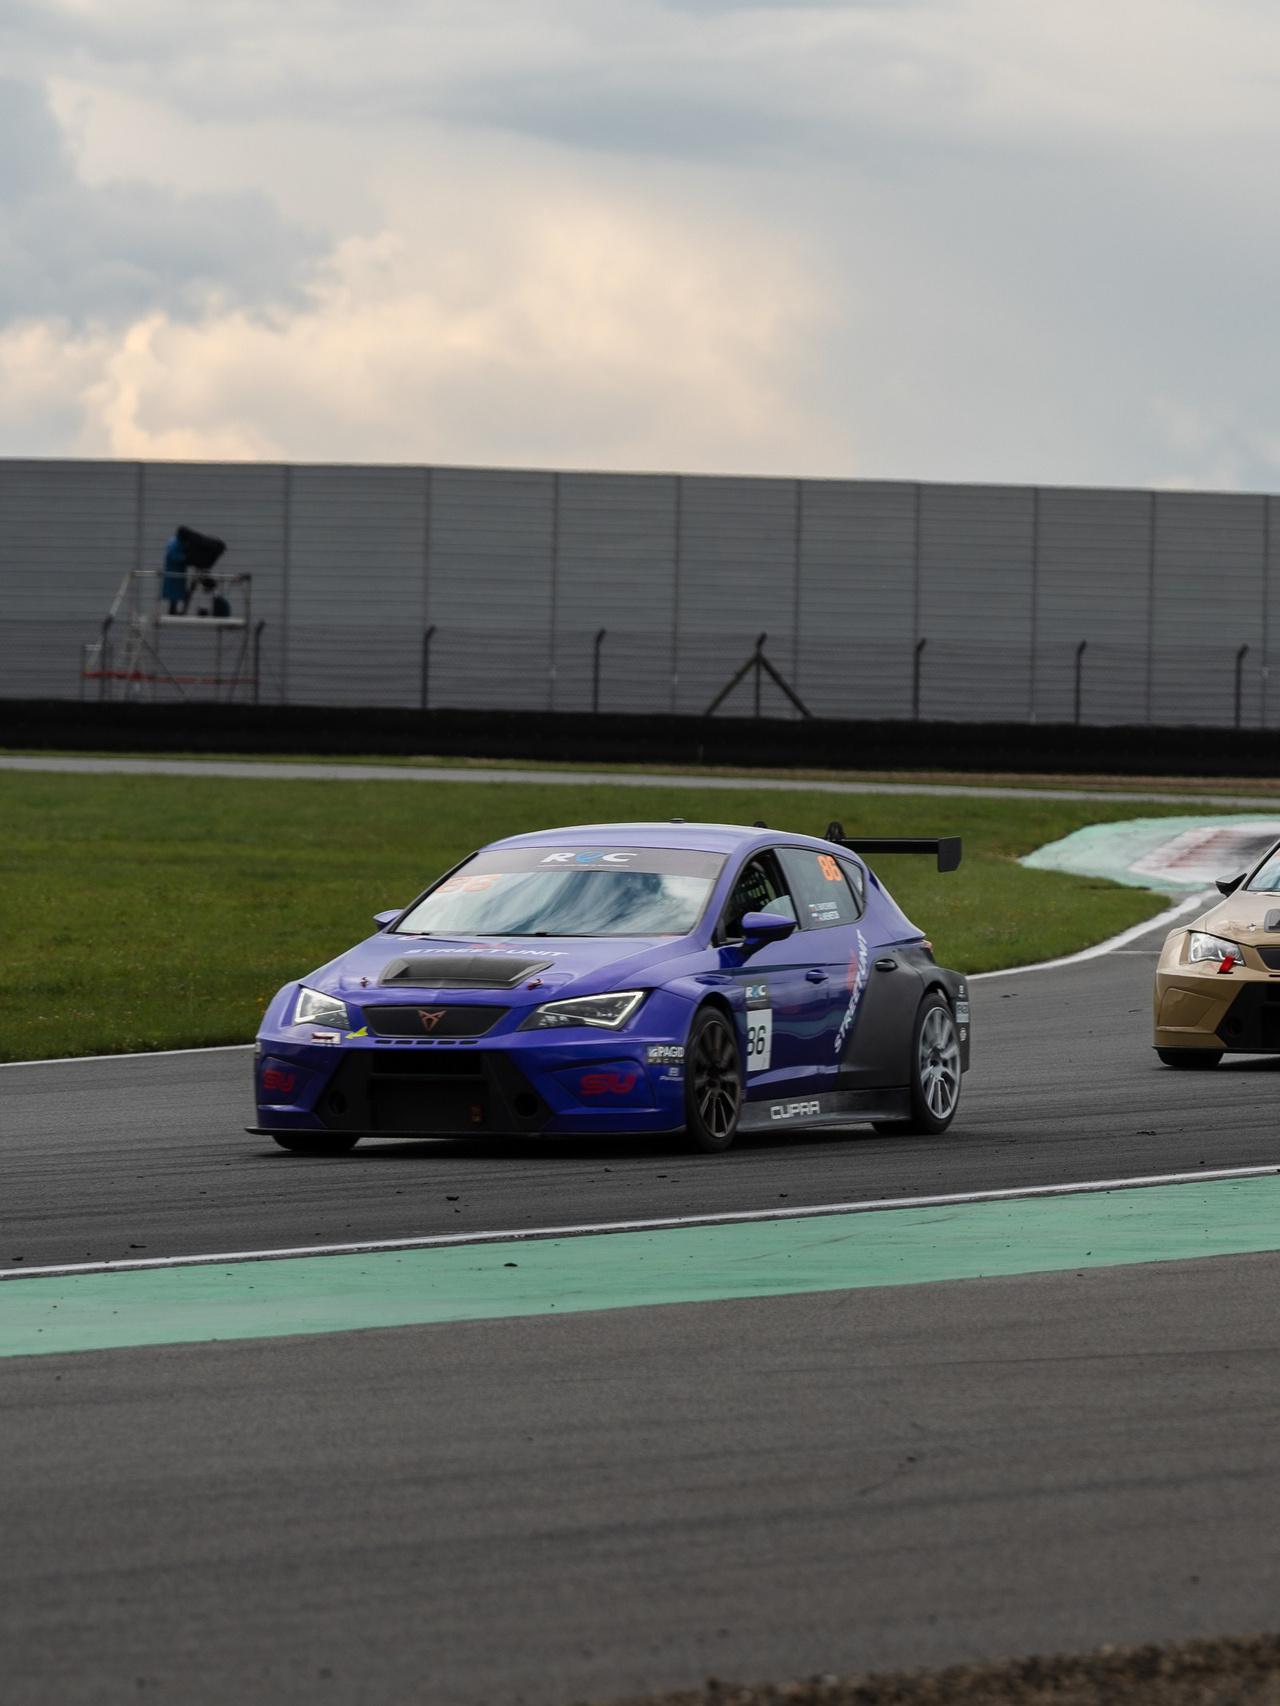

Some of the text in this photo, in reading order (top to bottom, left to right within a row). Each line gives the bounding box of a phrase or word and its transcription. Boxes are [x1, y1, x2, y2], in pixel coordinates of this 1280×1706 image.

[817, 855, 842, 881] 86
[435, 875, 500, 893] 86
[770, 1101, 820, 1119] CUPRA
